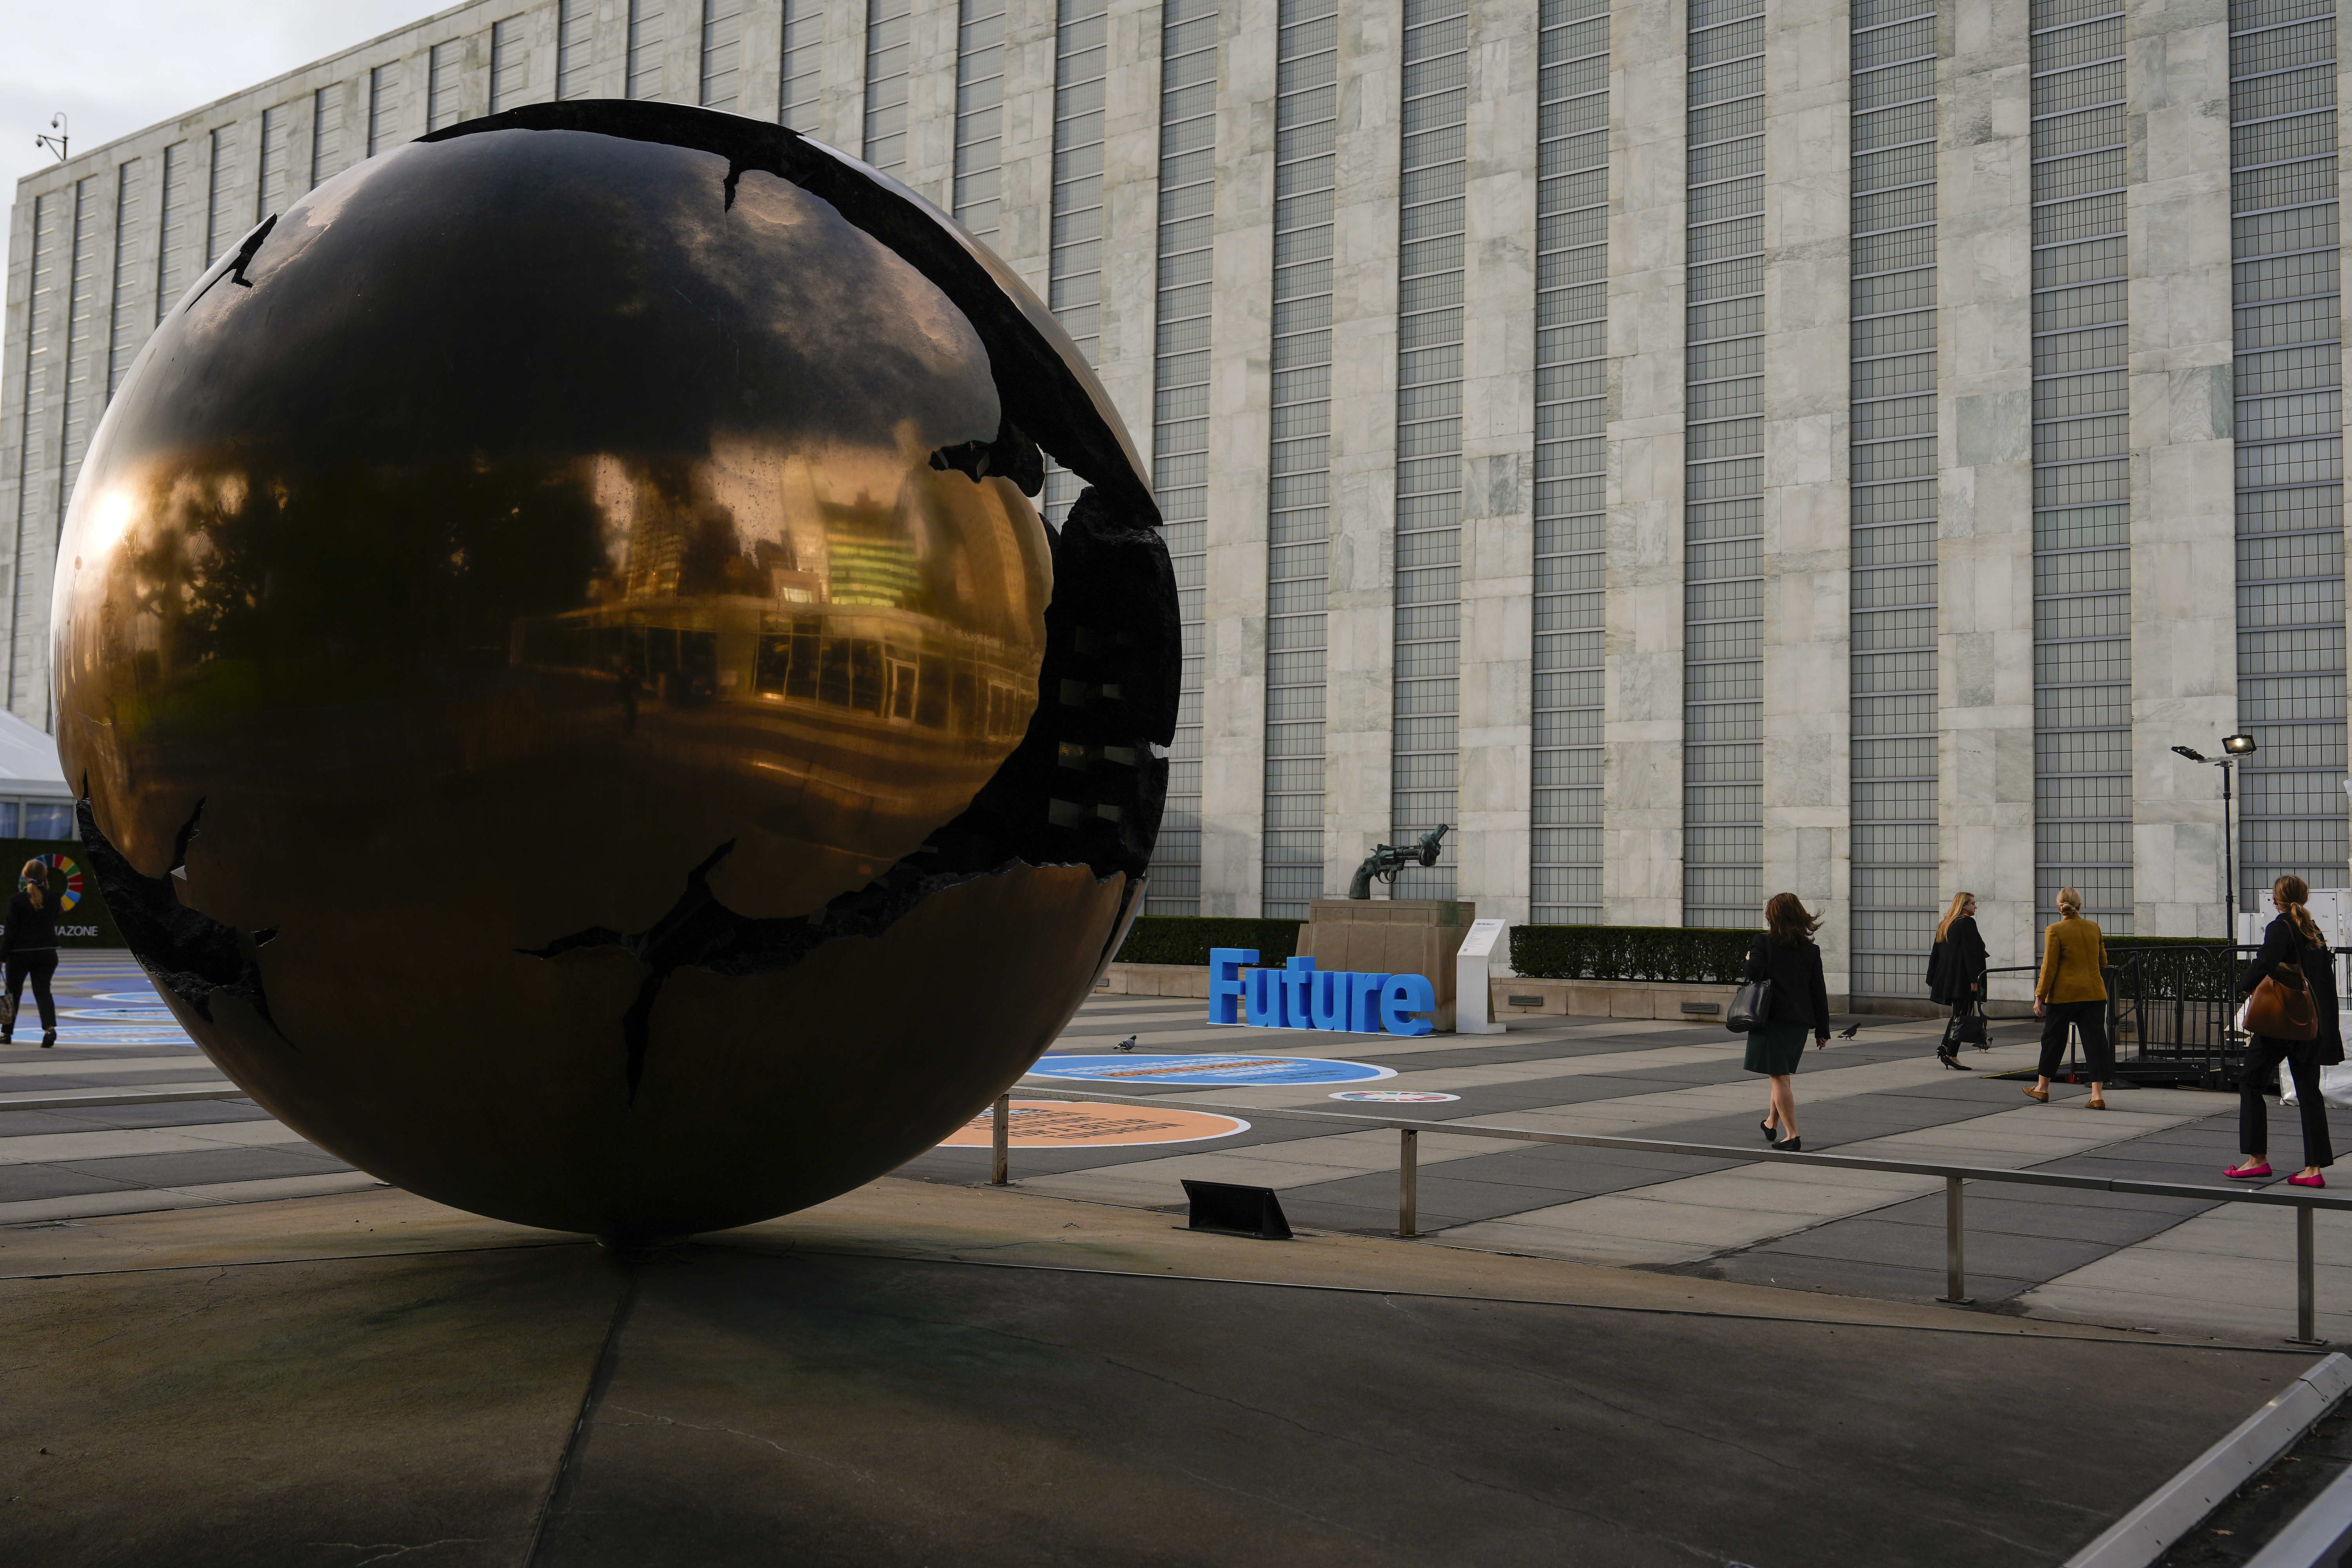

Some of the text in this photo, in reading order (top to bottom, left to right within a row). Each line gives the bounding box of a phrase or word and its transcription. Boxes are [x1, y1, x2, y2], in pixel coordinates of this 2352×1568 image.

[1209, 948, 1435, 1035] Future
[1042, 1123, 1186, 1139] TOMORROW
[1065, 1119, 1158, 1130] BETTER
